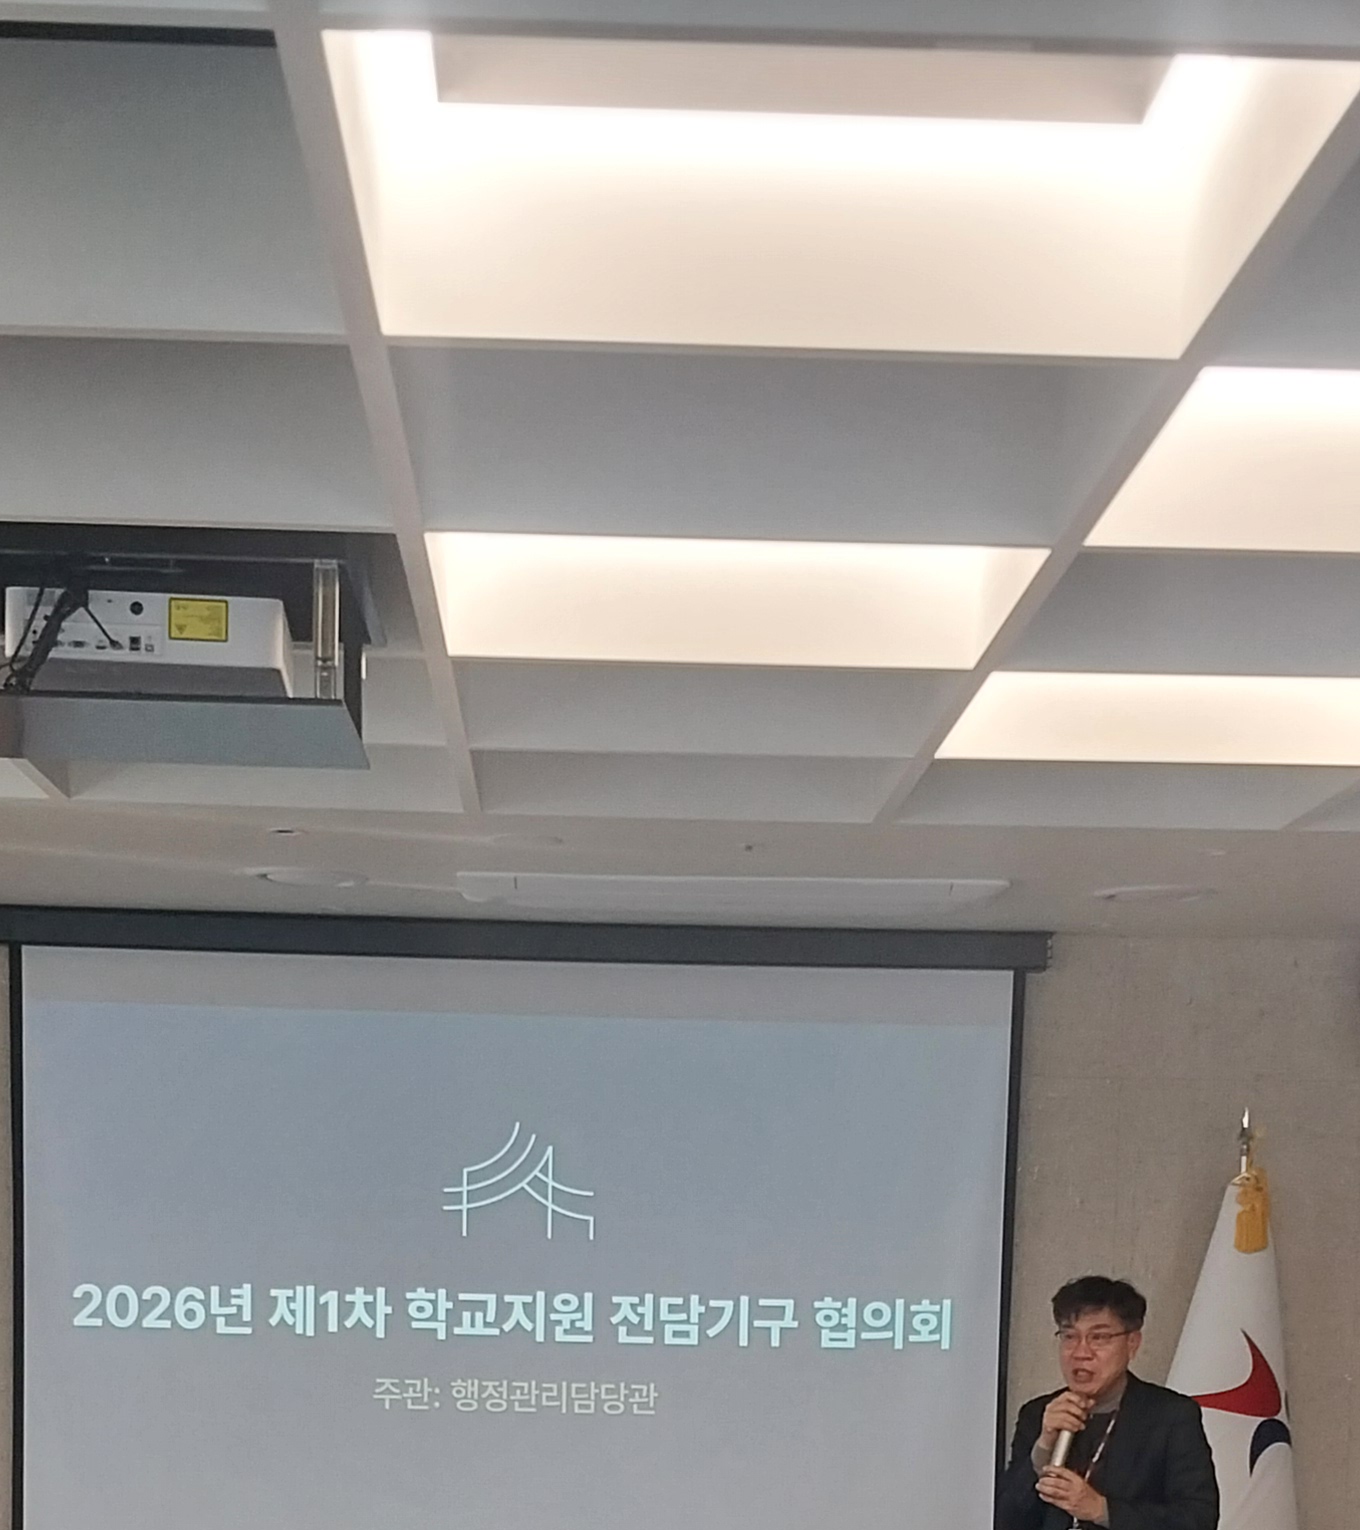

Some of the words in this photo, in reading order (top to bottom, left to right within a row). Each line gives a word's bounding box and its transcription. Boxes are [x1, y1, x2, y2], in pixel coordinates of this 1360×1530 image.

[72, 1283, 252, 1334] 2026년
[268, 1285, 392, 1338] 제1차
[405, 1287, 594, 1342] 학교지원
[610, 1292, 799, 1347] 전담기구
[814, 1296, 952, 1350] 협의회
[373, 1378, 441, 1410] 주관:
[450, 1379, 659, 1415] 행정관리담당관
